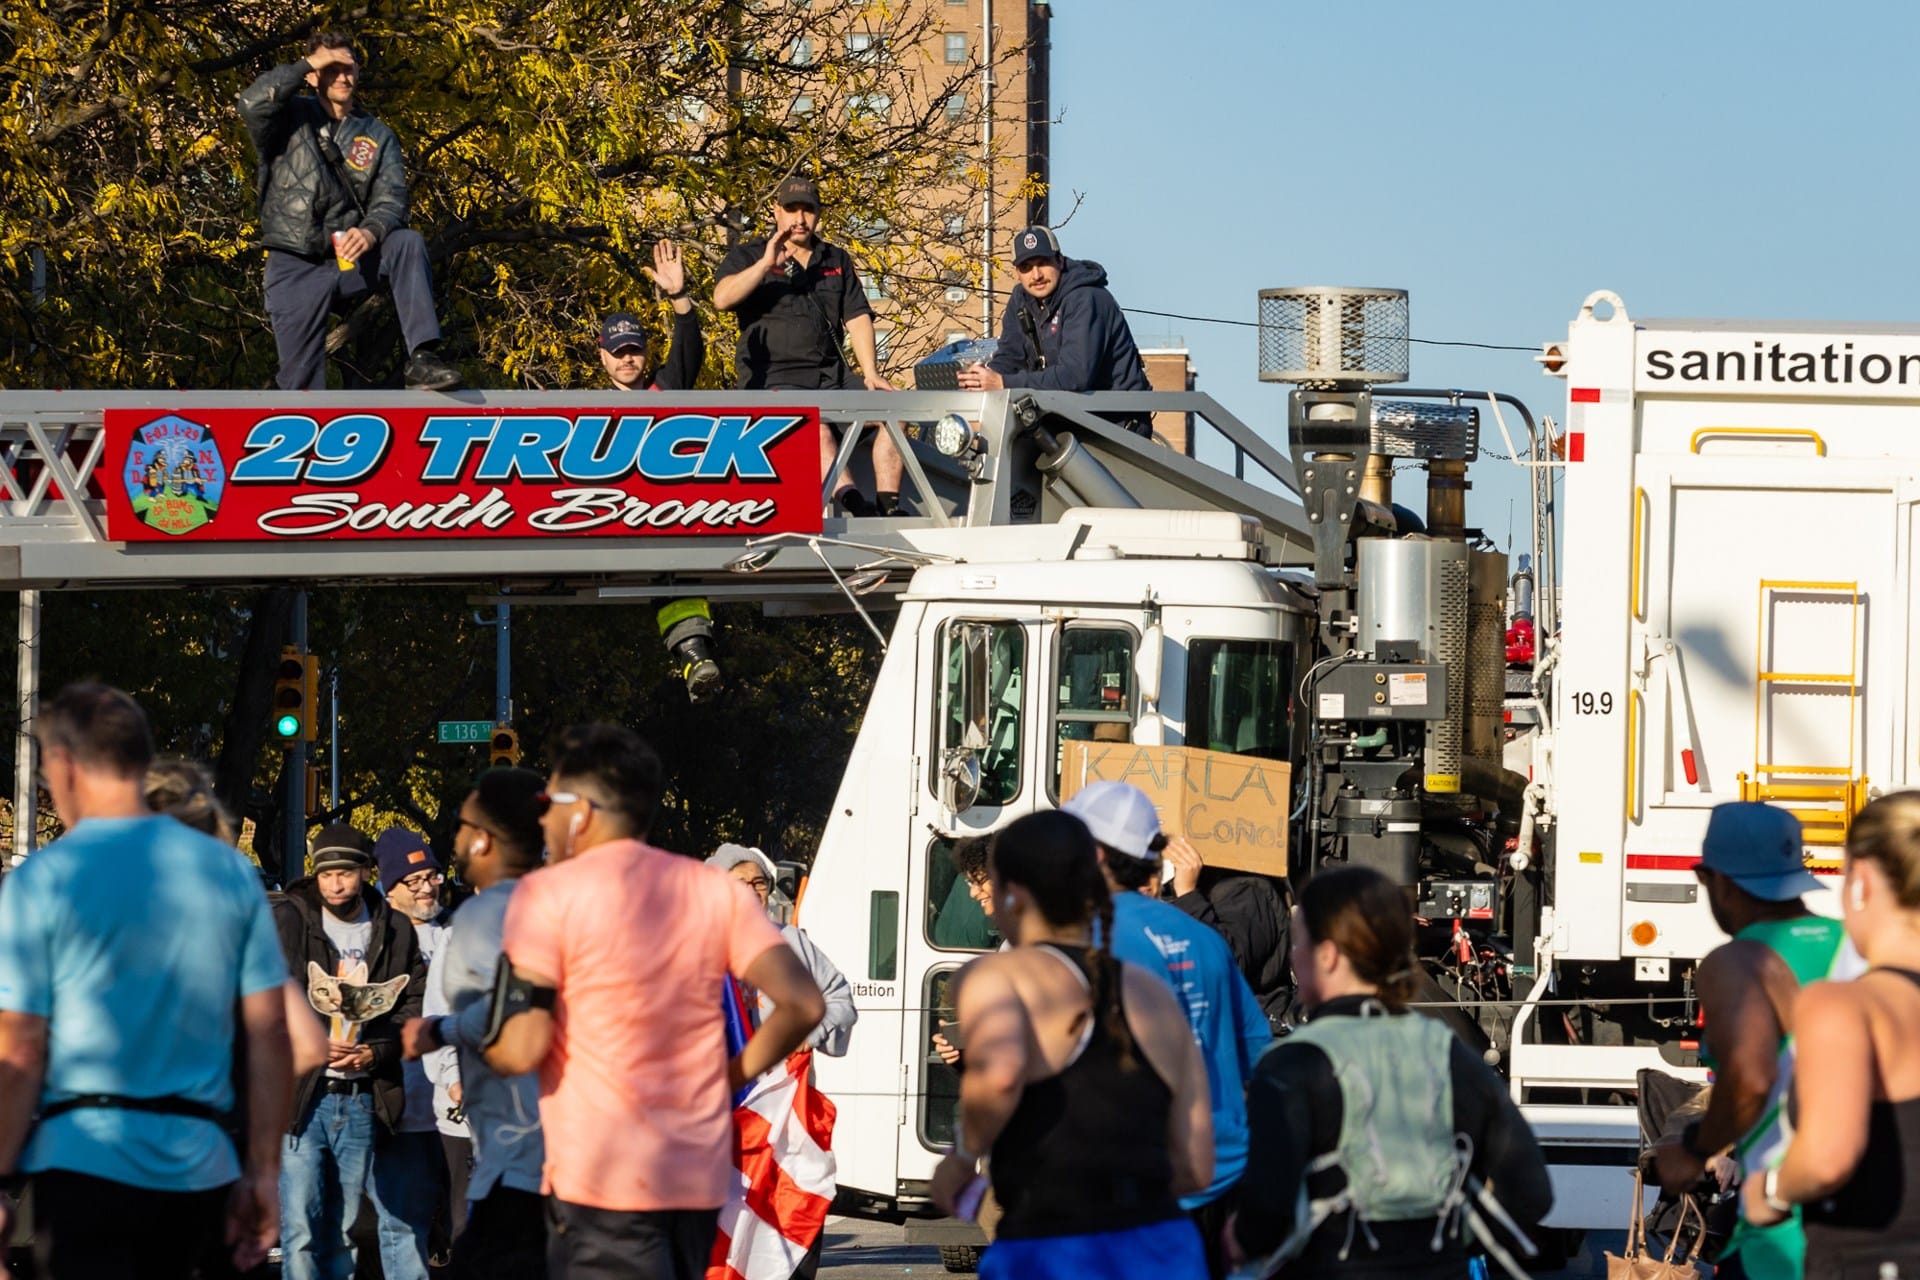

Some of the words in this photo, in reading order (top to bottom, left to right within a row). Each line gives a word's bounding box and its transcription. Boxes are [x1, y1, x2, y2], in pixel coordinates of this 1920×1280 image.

[1646, 341, 1920, 384] sanitation
[229, 414, 391, 482] 29
[421, 414, 804, 482] TRUCK
[257, 488, 513, 534] South
[527, 488, 775, 531] Bronx
[1571, 691, 1613, 715] 19.9
[441, 725, 448, 739] E
[455, 724, 478, 739] 136
[1081, 744, 1277, 806] KARLA
[852, 982, 895, 997] itation
